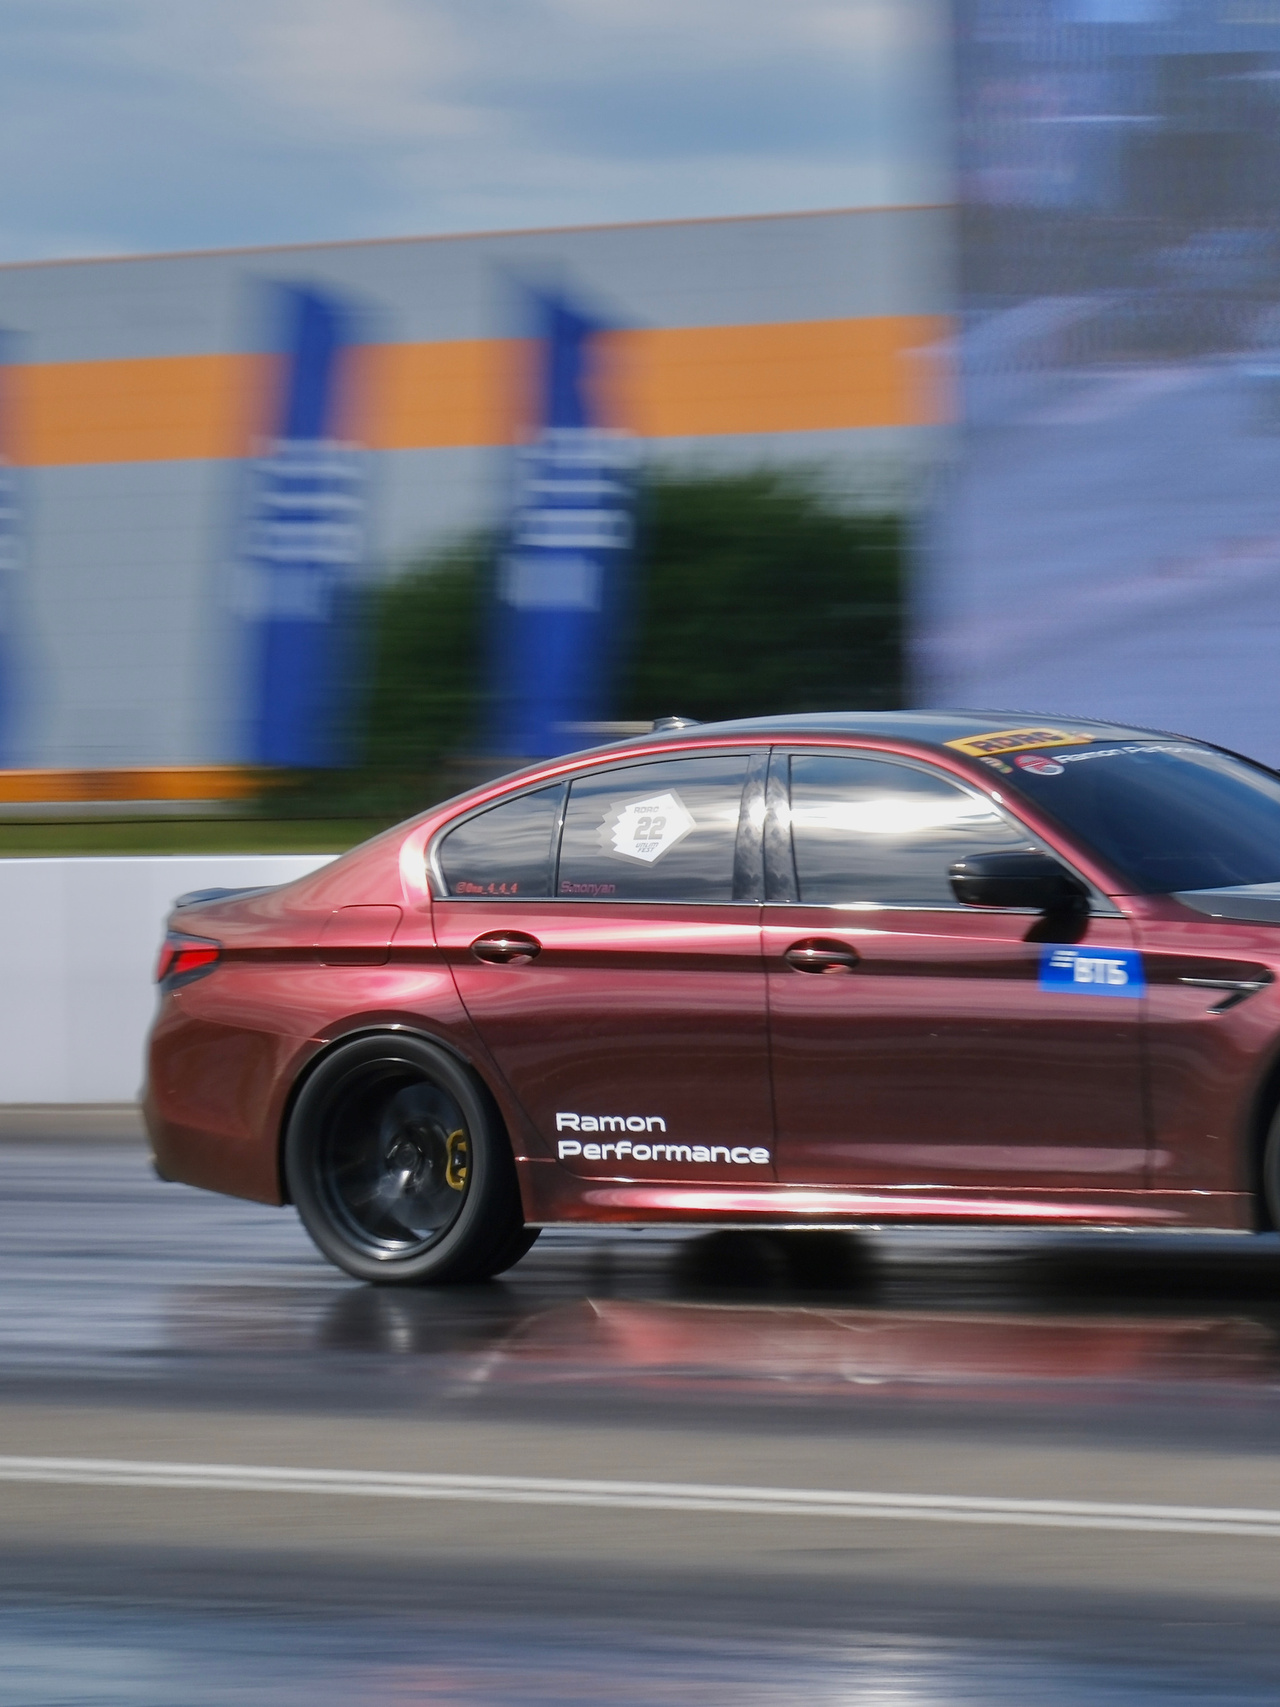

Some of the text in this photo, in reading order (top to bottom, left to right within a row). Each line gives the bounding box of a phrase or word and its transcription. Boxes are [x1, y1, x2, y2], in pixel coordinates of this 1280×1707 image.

[633, 816, 667, 840] 22
[555, 1112, 667, 1132] Ramon
[557, 1140, 770, 1164] Performance
